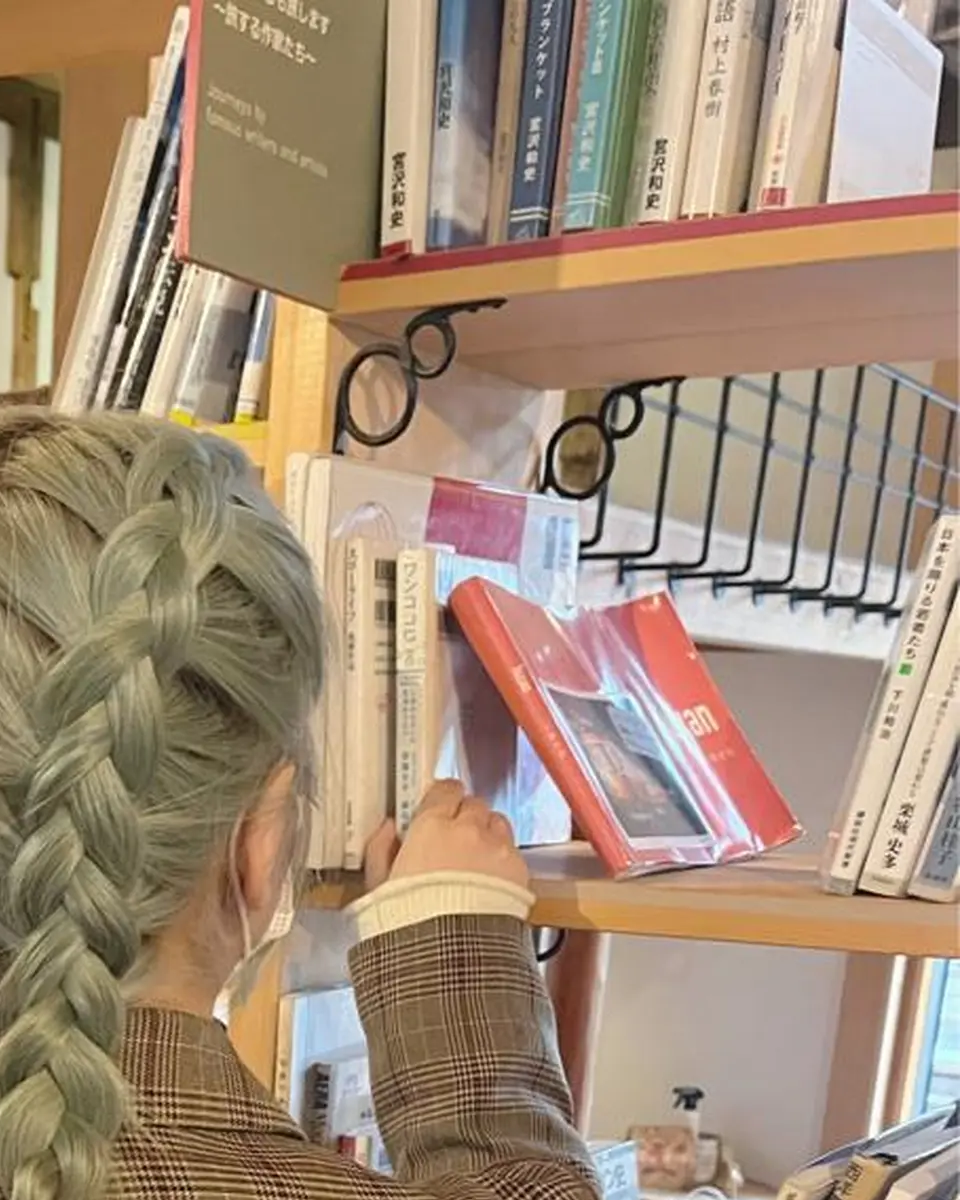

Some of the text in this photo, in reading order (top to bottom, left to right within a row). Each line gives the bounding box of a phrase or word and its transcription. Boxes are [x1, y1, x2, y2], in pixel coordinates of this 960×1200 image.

[704, 34, 731, 119] 村上春樹
[645, 138, 668, 211] 宮沢和史
